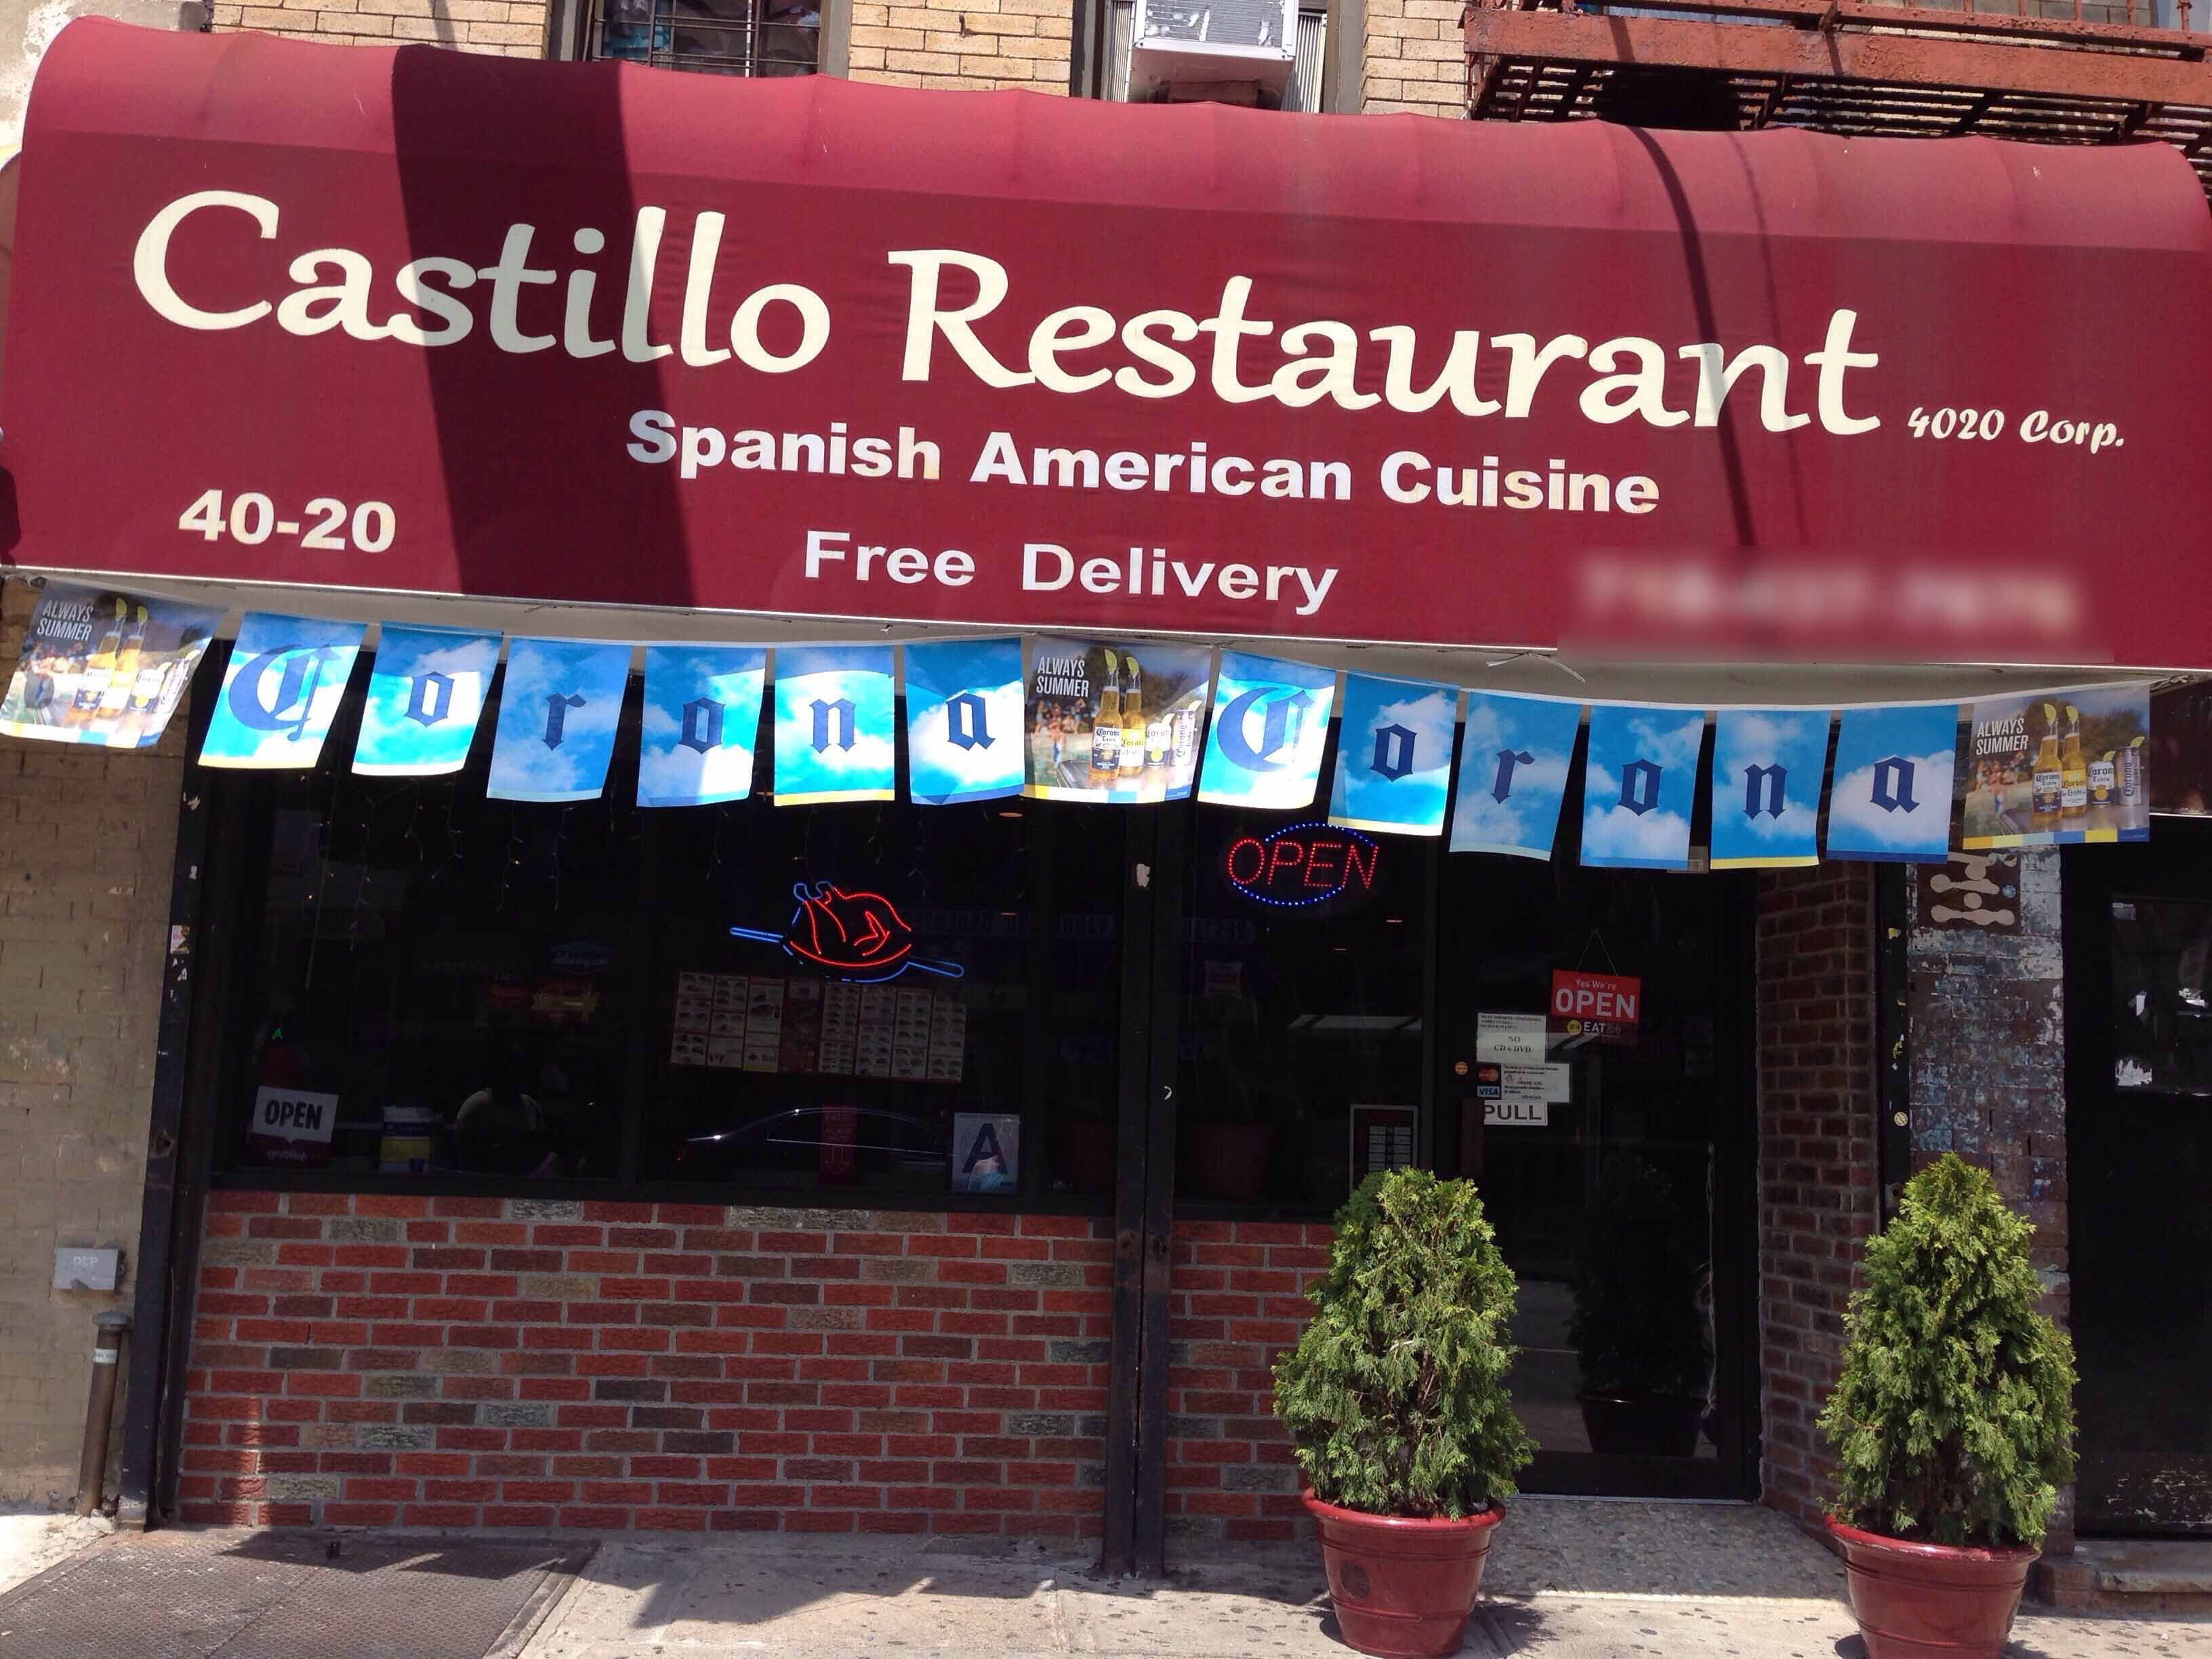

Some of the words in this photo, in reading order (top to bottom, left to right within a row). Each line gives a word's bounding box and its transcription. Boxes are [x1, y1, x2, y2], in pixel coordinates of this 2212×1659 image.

[134, 190, 830, 374] Castillo
[888, 249, 1881, 435] Restaurant
[1907, 407, 2005, 441] 4020
[2020, 409, 2125, 454] Corp.
[626, 409, 941, 481] Spanish
[970, 430, 1351, 501] American
[1380, 450, 1660, 514] Cuisine
[178, 489, 396, 554] 40-20
[805, 530, 977, 588] Free
[1021, 543, 1339, 615] Delivery
[42, 599, 94, 622] ALWAYS
[37, 617, 93, 642] SUMMER
[1037, 656, 1086, 677] ALWAYS
[1036, 675, 1090, 698] SUMMER
[1976, 717, 2024, 737] ALWAYS
[1975, 734, 2029, 756] SUMMER
[1226, 836, 1381, 890] OPEN
[1576, 979, 1590, 988] Yes
[1592, 981, 1617, 990] We're
[1555, 987, 1636, 1019] OPEN
[1479, 1088, 1499, 1096] VISA
[265, 1099, 323, 1130] OPEN
[1485, 1104, 1542, 1120] PULL
[962, 1122, 1008, 1174] A
